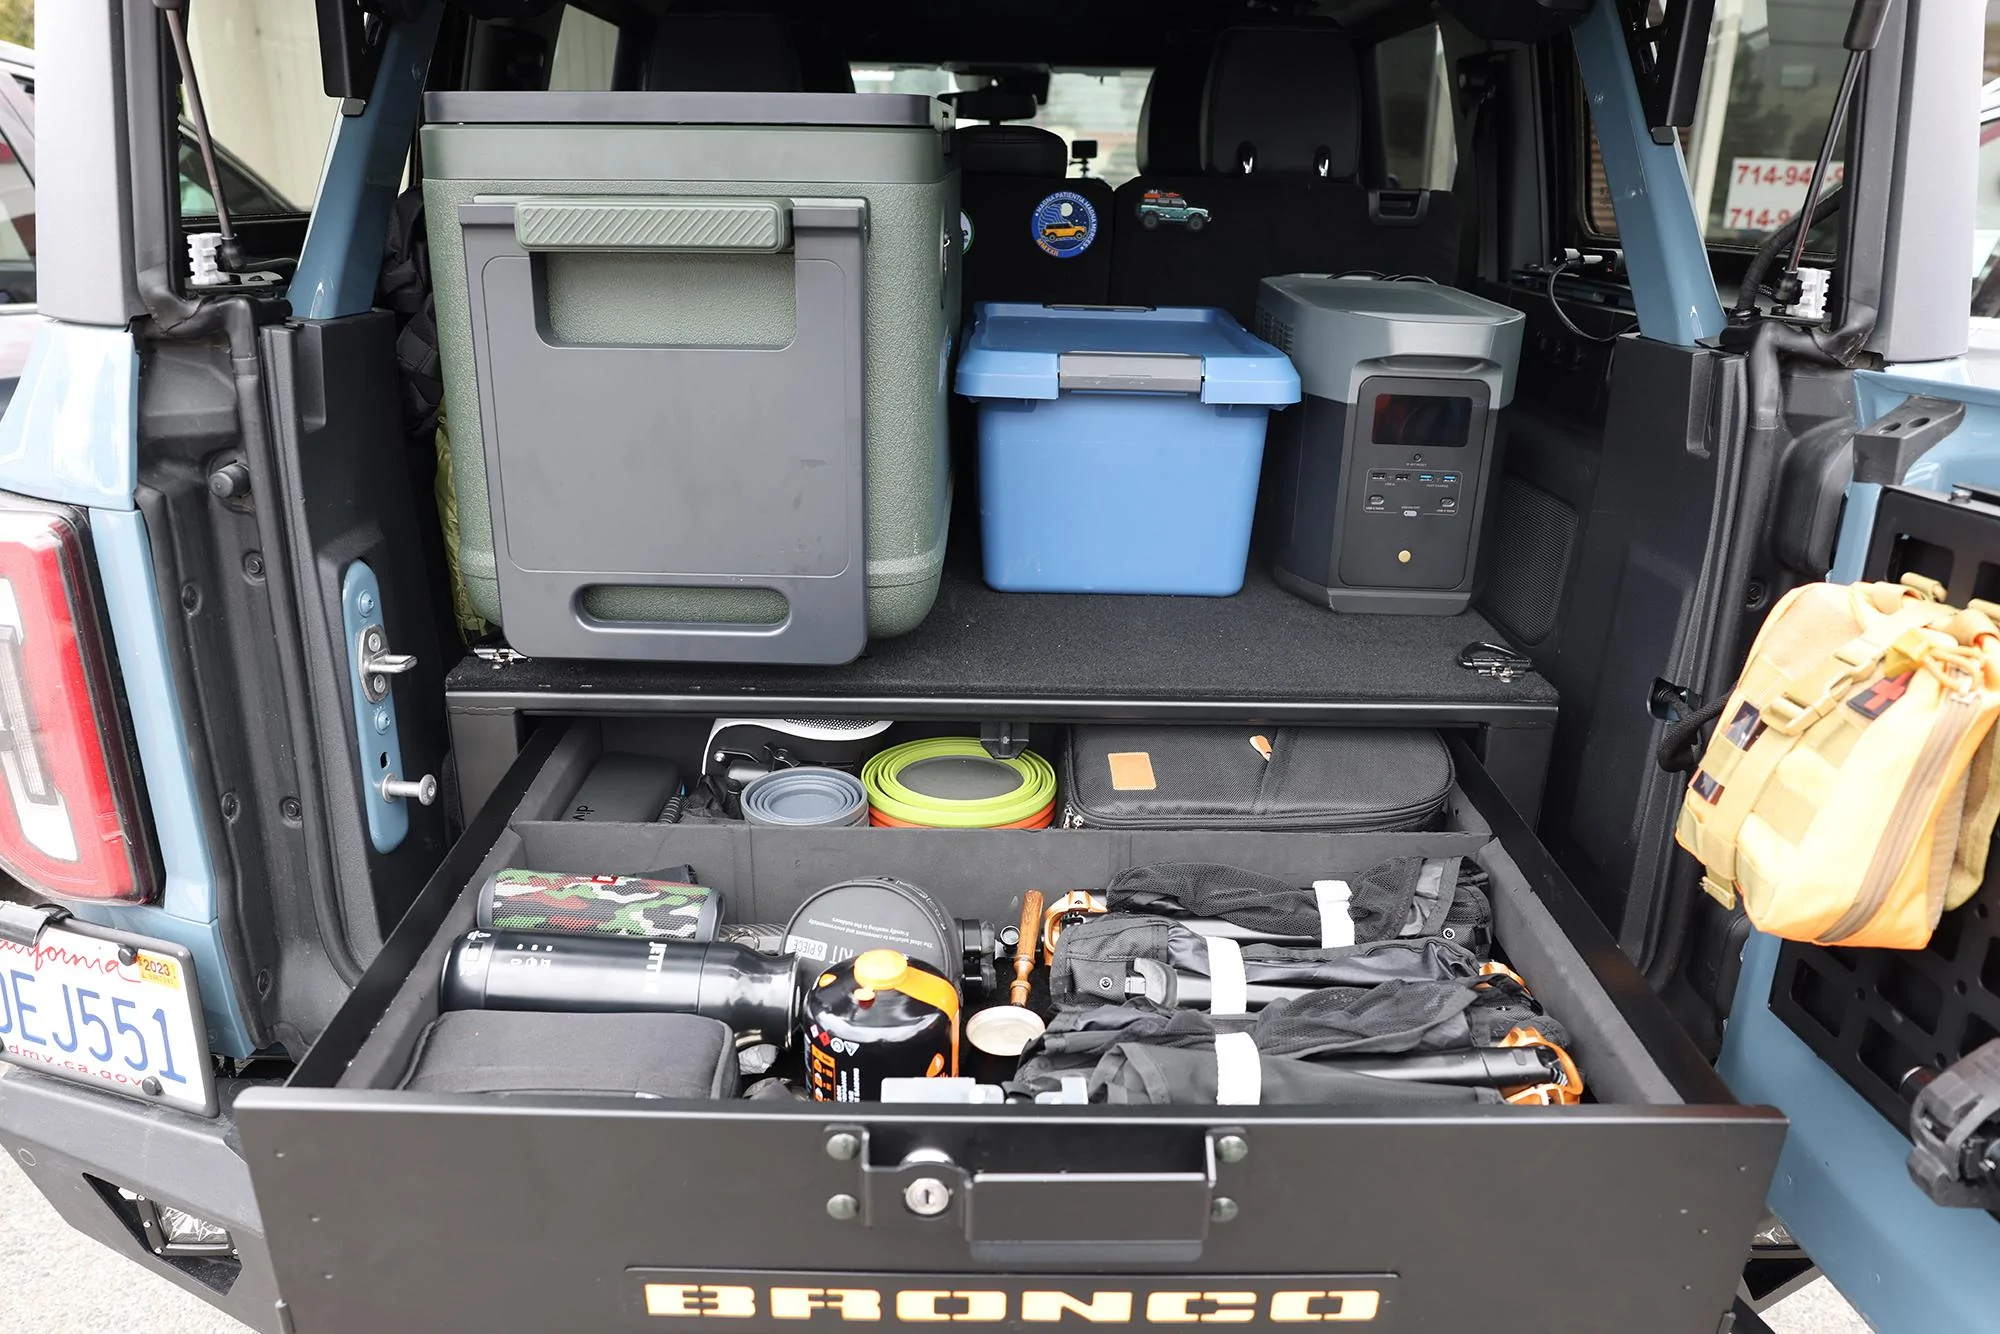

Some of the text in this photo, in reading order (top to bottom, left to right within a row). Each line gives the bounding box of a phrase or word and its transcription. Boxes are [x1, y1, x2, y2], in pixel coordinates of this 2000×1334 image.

[1036, 195, 1056, 213] MAGNA
[1055, 191, 1084, 204] PATIENTIA
[1083, 201, 1097, 223] MAGNA
[143, 958, 171, 976] 2023
[645, 1283, 1380, 1322] BRONCO
